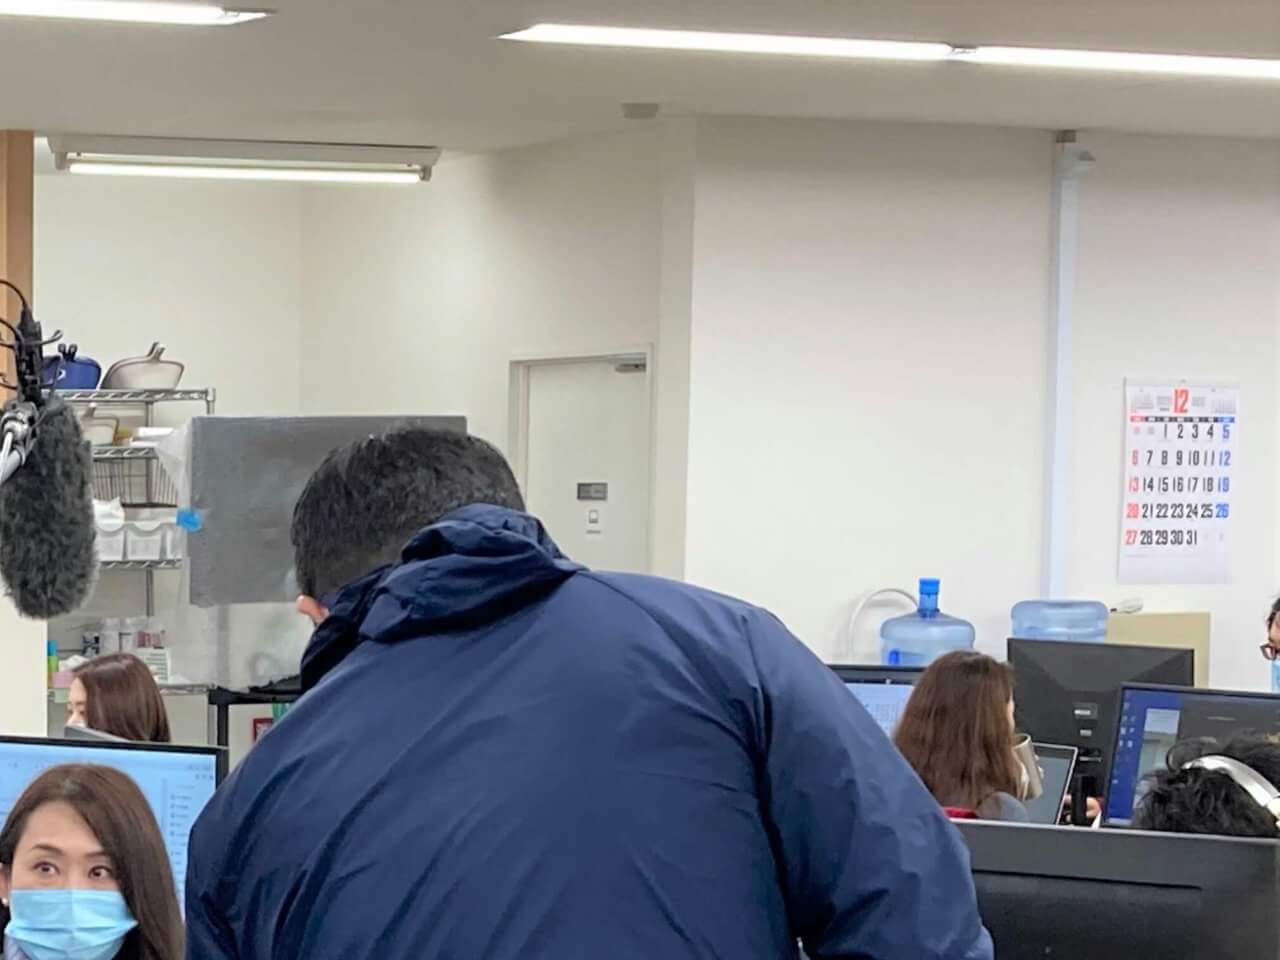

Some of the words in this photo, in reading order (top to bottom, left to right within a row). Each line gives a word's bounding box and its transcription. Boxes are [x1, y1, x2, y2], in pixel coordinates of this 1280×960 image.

[1174, 389, 1189, 413] 12
[1164, 424, 1168, 439] 1
[1177, 424, 1184, 439] 2
[1192, 424, 1199, 439] 3
[1207, 424, 1214, 439] 4
[1223, 424, 1230, 439] 5
[1132, 450, 1138, 466] 6
[1147, 450, 1153, 466] 7
[1161, 450, 1168, 466] 8
[1176, 450, 1183, 466] 9
[1188, 450, 1200, 466] 10
[1204, 450, 1215, 466] 11
[1219, 450, 1231, 466] 12
[1143, 477, 1154, 492] 14
[1158, 477, 1168, 492] 15
[1173, 477, 1184, 492] 16
[1188, 477, 1199, 492] 17
[1203, 477, 1214, 492] 18
[1142, 504, 1153, 518] 21
[1156, 504, 1168, 518] 22
[1170, 504, 1184, 518] 23
[1186, 504, 1198, 518] 24
[1201, 504, 1213, 518] 25
[1216, 504, 1230, 518] 26
[1126, 530, 1138, 545] 27
[1140, 530, 1153, 545] 28
[1155, 530, 1168, 545] 29
[1170, 530, 1184, 545] 30
[1186, 530, 1197, 545] 31
